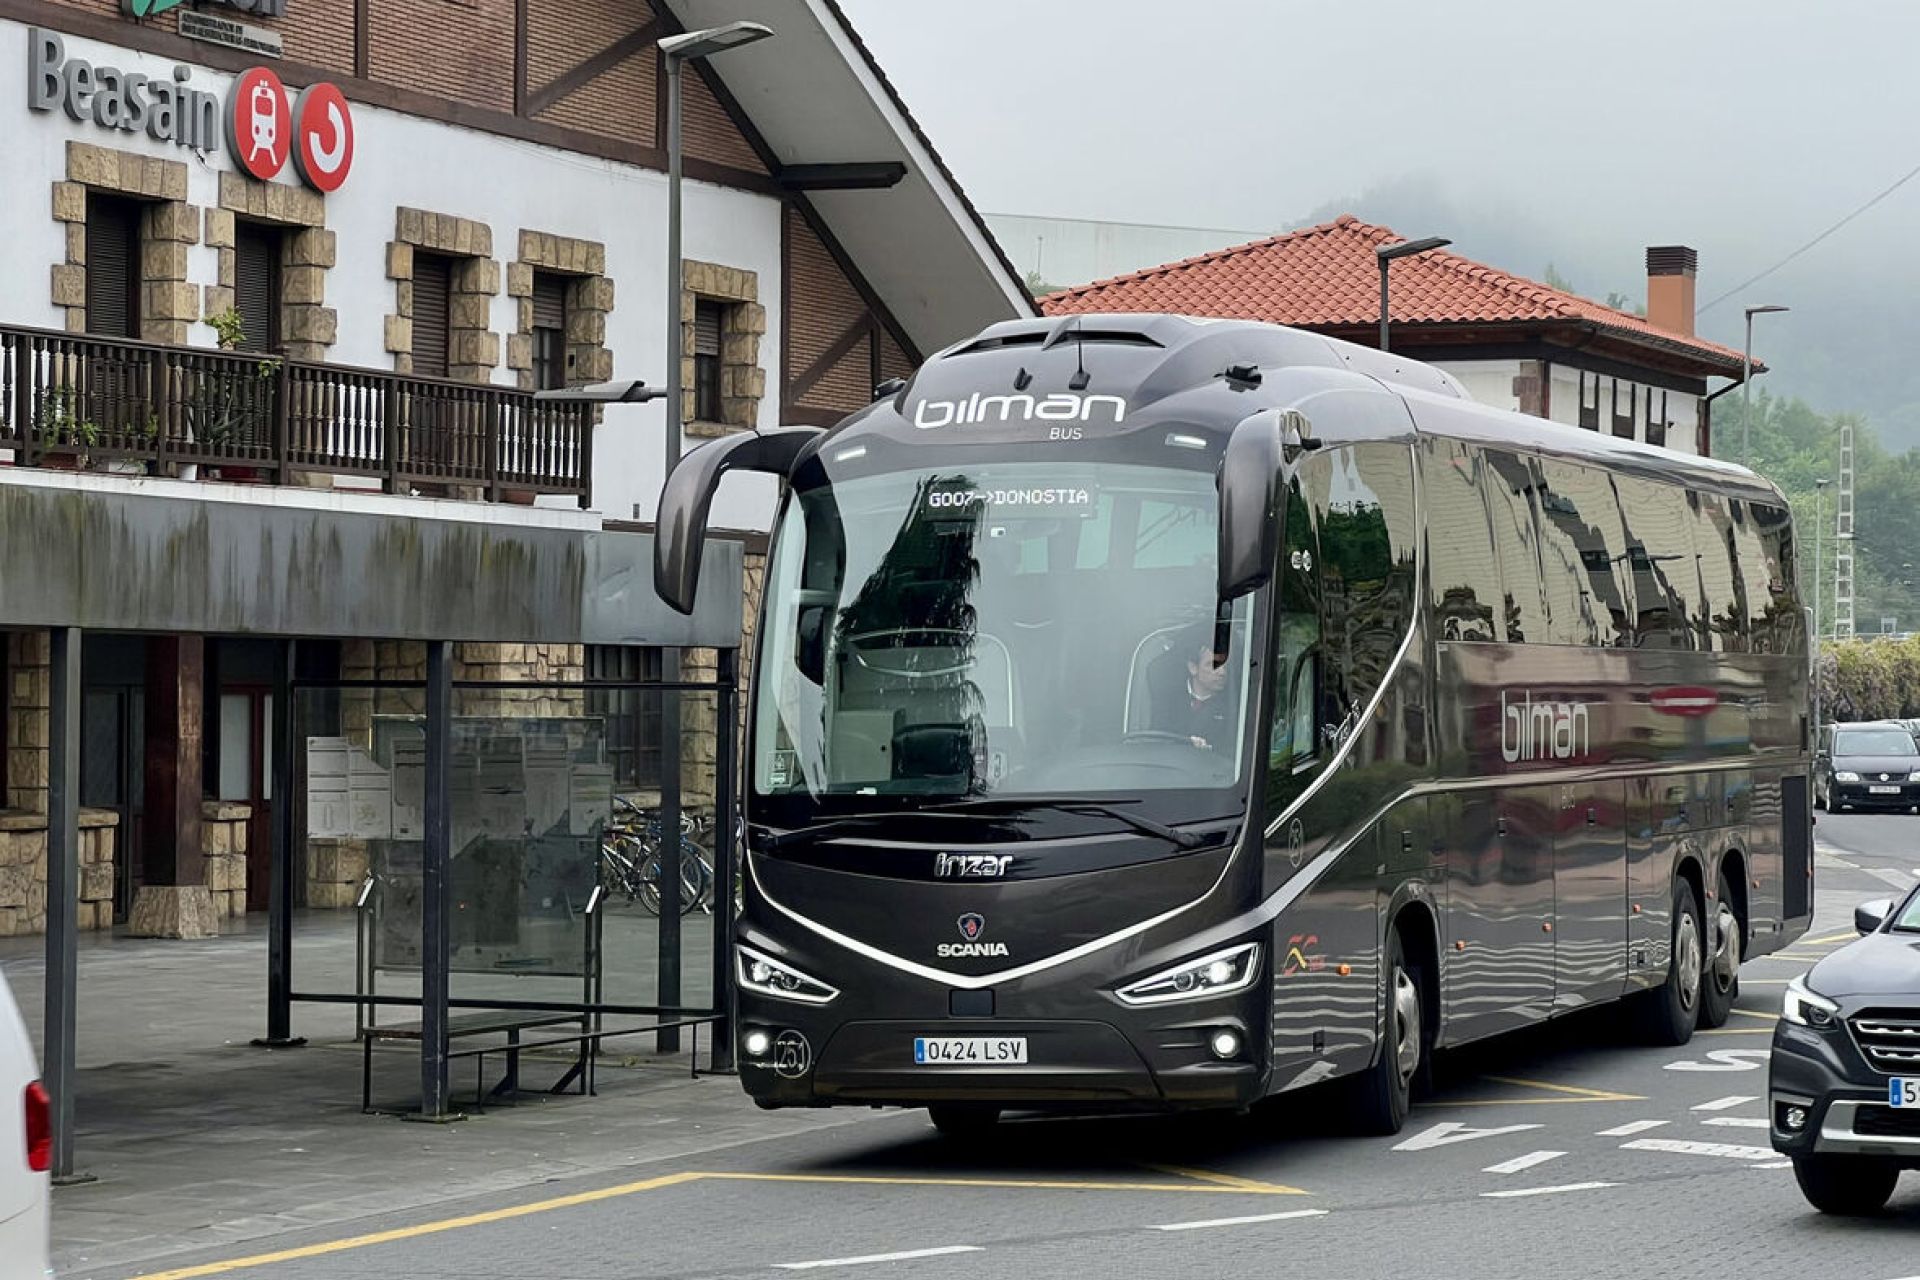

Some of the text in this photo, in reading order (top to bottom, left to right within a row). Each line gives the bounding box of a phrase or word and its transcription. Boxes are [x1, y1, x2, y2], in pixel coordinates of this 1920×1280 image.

[28, 27, 219, 152] Beasain
[914, 392, 1126, 429] bilman
[1050, 427, 1083, 440] BUS
[1502, 689, 1588, 762] bilman
[937, 943, 1009, 957] SCANIA
[928, 1041, 1021, 1060] 0424 LSV
